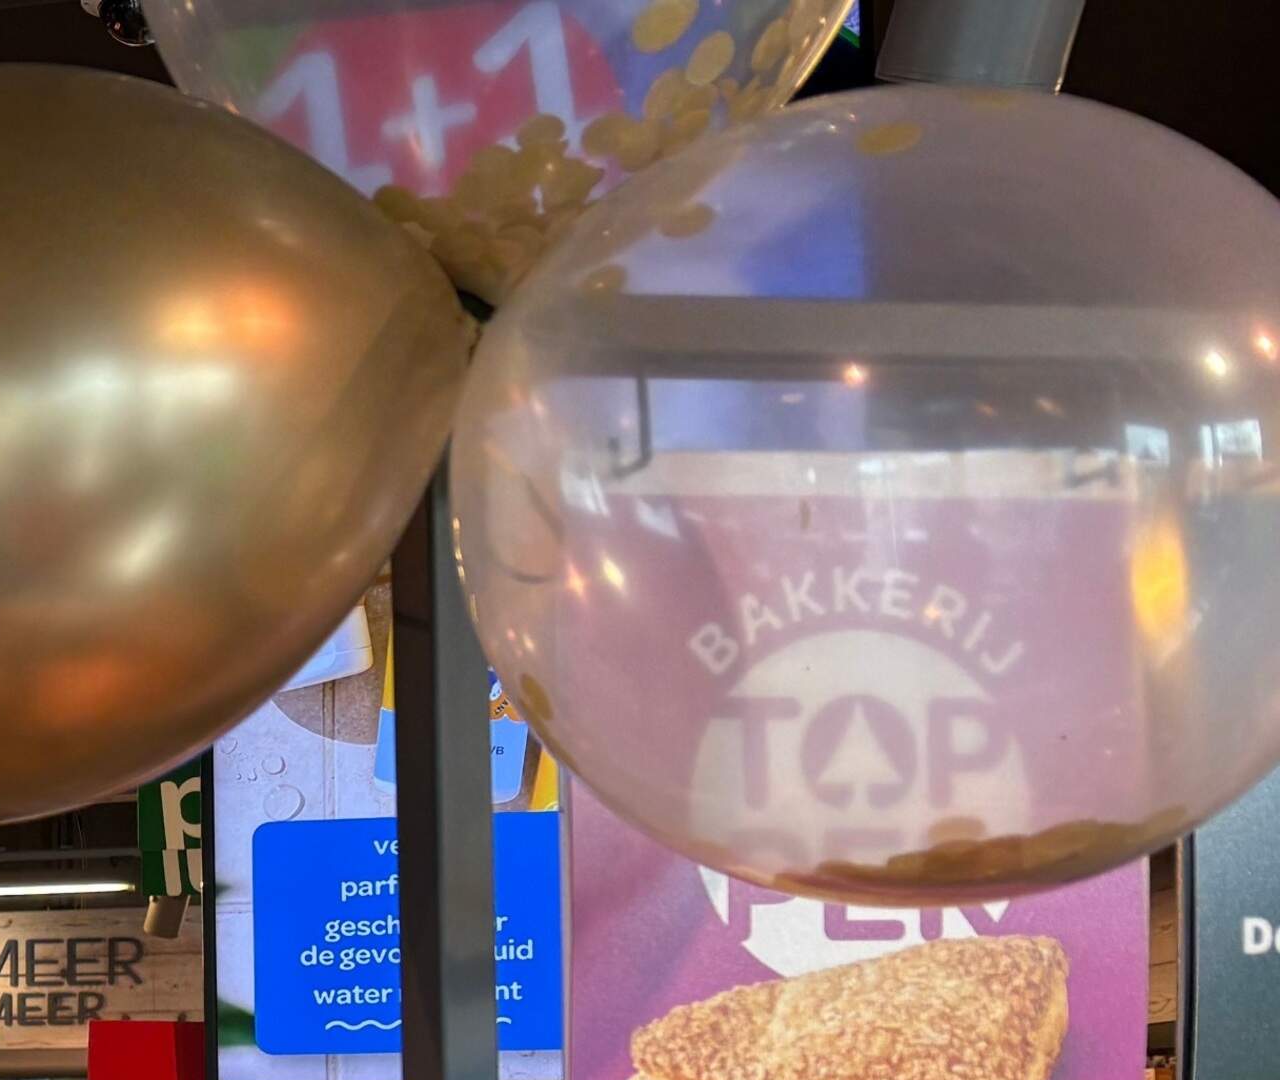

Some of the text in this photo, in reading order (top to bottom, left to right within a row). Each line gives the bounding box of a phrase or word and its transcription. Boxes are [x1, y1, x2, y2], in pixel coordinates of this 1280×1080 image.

[687, 565, 1025, 677] BAKKERIJ
[299, 944, 334, 967] de
[312, 986, 392, 1005] water
